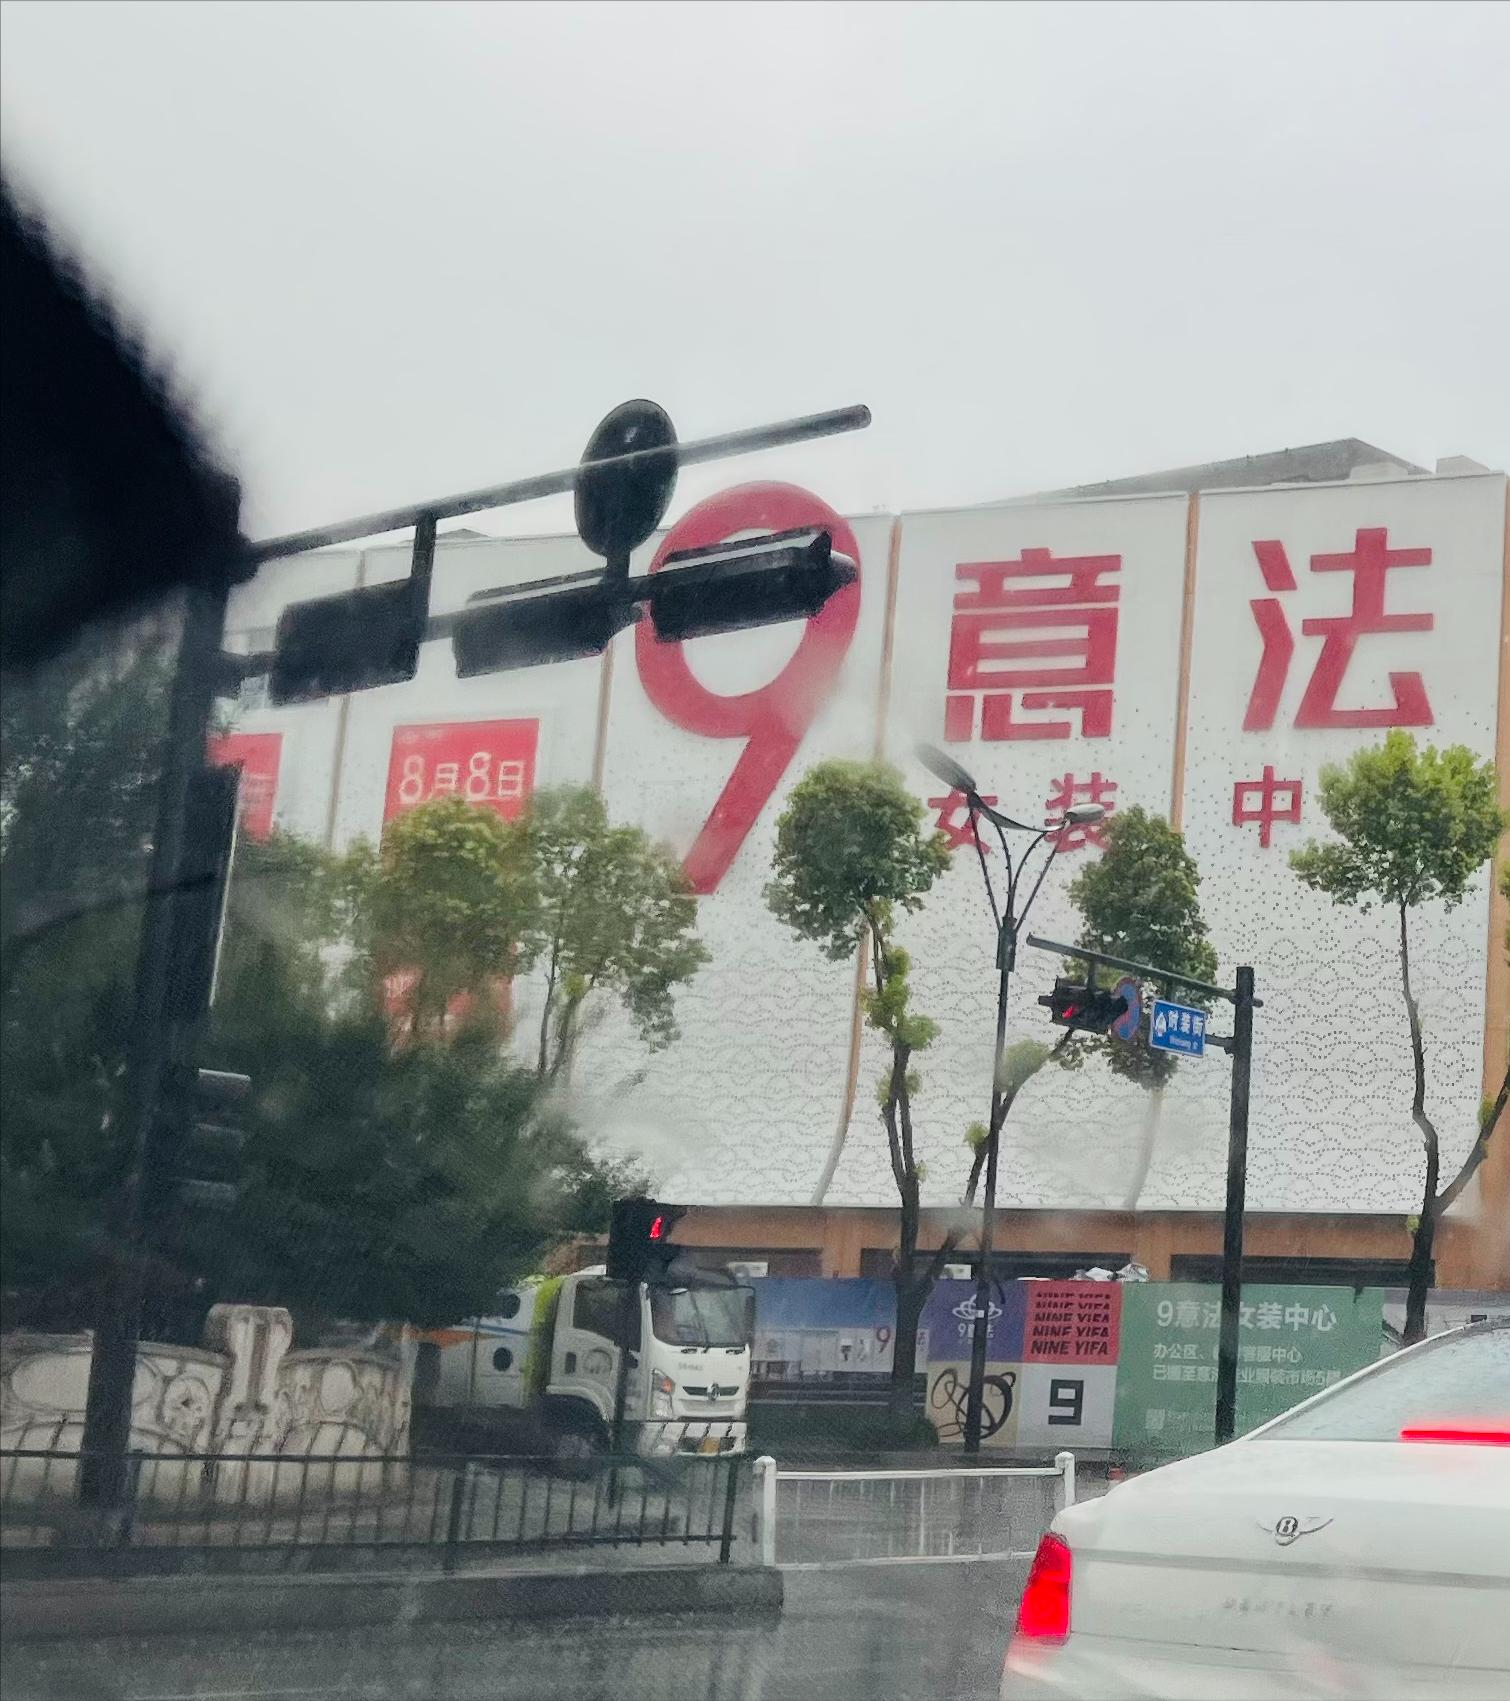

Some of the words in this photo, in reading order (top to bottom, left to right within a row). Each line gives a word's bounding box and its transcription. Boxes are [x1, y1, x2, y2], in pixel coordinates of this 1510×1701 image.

[399, 751, 527, 804] 8月8日
[1033, 1325, 1073, 1337] NINE
[1076, 1326, 1110, 1338] YIFA
[1031, 1340, 1072, 1355] NINE
[1075, 1340, 1109, 1356] YIFA
[1153, 1342, 1302, 1363] 办公区、客服中心
[1048, 1379, 1084, 1426] 9
